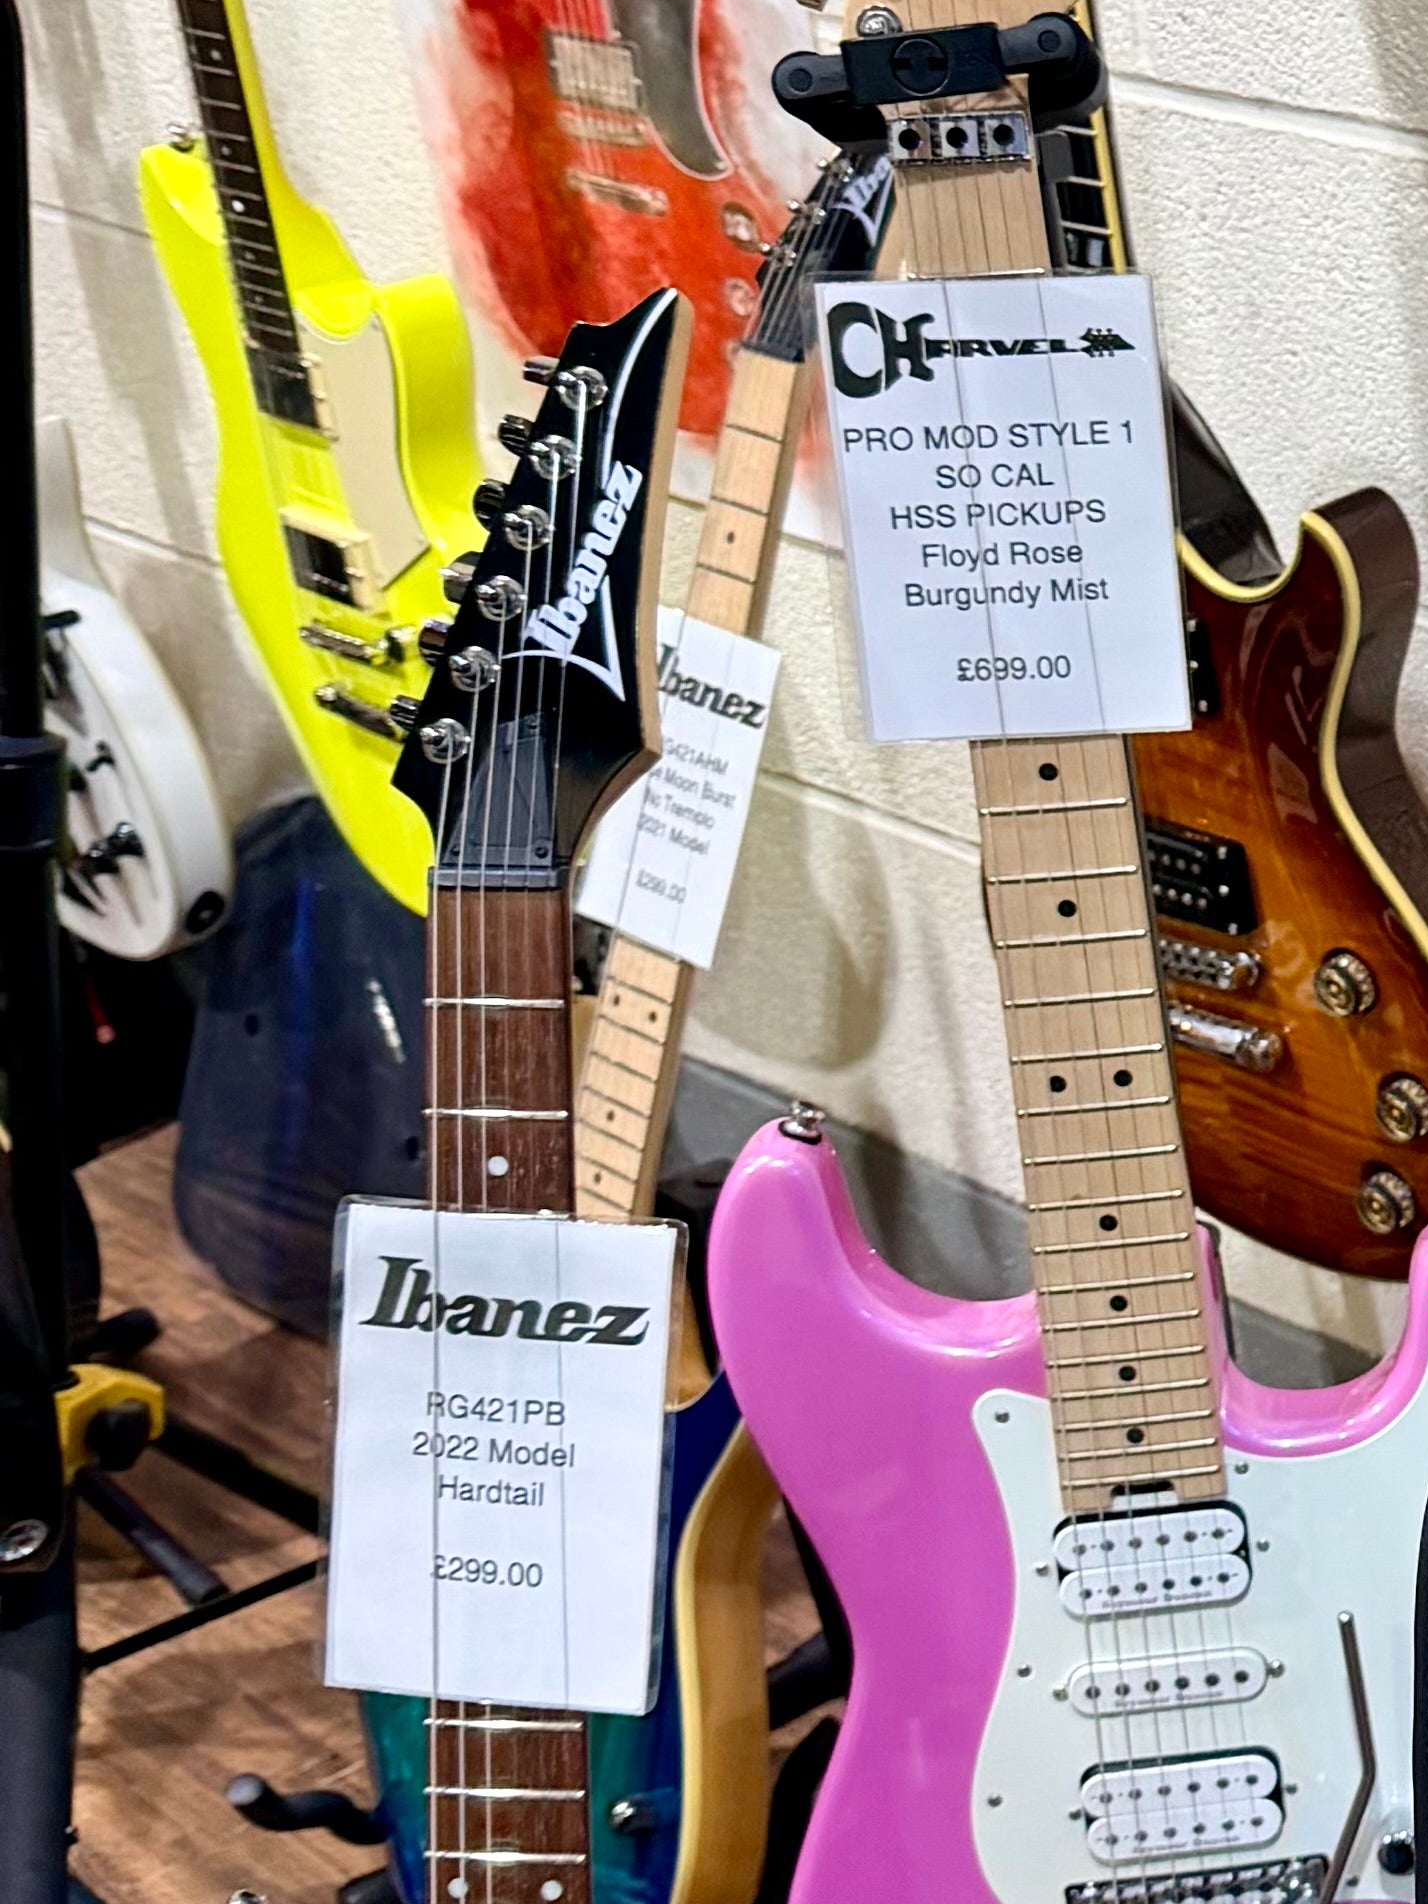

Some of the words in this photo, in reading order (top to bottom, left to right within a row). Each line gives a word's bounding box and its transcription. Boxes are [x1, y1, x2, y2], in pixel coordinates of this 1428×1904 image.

[844, 427, 913, 454] PRO
[925, 424, 998, 450] MOD
[1008, 421, 1109, 449] STYLE
[1121, 420, 1134, 445] 1
[935, 465, 981, 489] SO
[990, 463, 1054, 488] CAL
[890, 505, 957, 530] HSS
[967, 500, 1106, 528] PICKUPS
[523, 459, 643, 656] Ibanez
[922, 542, 1000, 574] Floyd
[1009, 542, 1083, 565] Rose
[905, 580, 1041, 611] Burgundy
[1051, 577, 1109, 602] Mist
[957, 656, 1072, 683] £699.00
[358, 1256, 650, 1346] Ibanez
[426, 1391, 566, 1427] RG421PB
[412, 1432, 479, 1462] 2022
[489, 1440, 576, 1468] Model
[437, 1474, 545, 1508] Hardtail
[431, 1554, 543, 1588] £299.00
